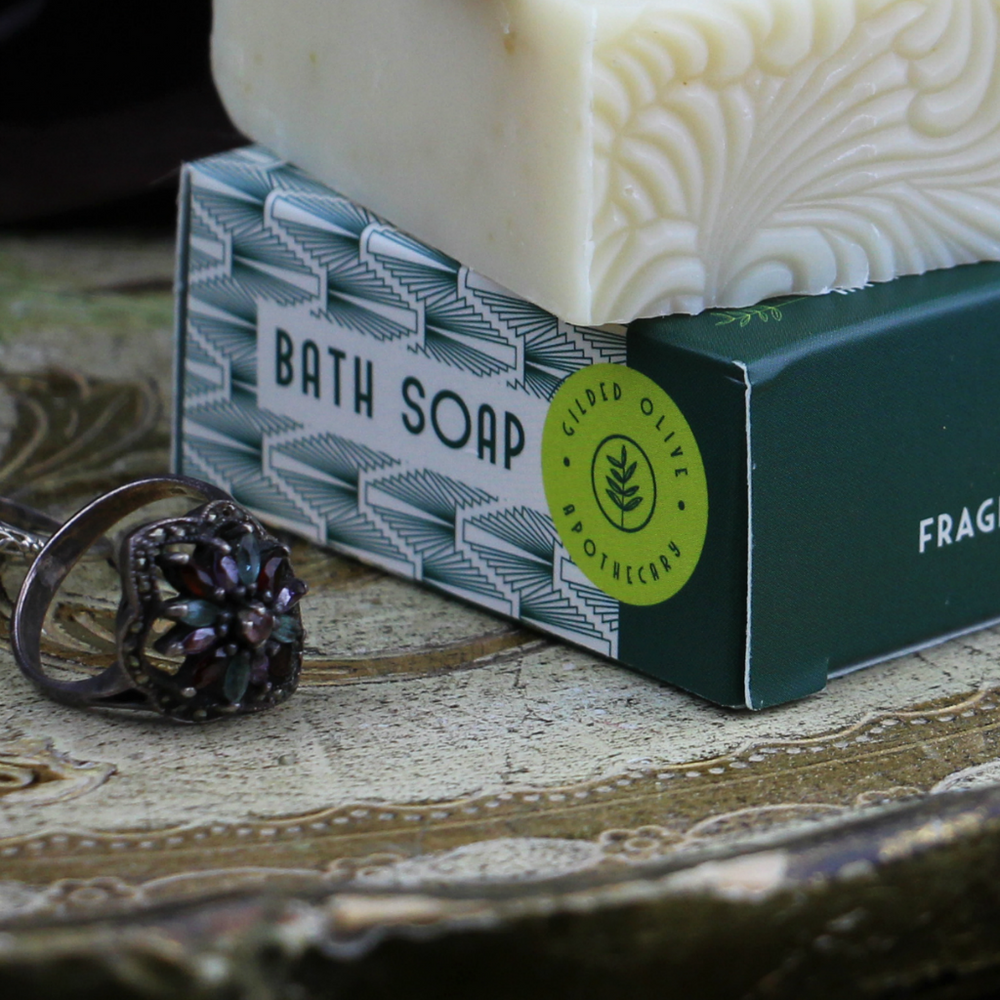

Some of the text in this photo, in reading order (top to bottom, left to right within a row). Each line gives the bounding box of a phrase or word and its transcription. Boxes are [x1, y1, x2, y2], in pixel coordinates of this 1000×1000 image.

[273, 327, 527, 471] BATH SOAP
[562, 381, 689, 478] GILDED OLIVE
[562, 503, 682, 586] APOTHECARY
